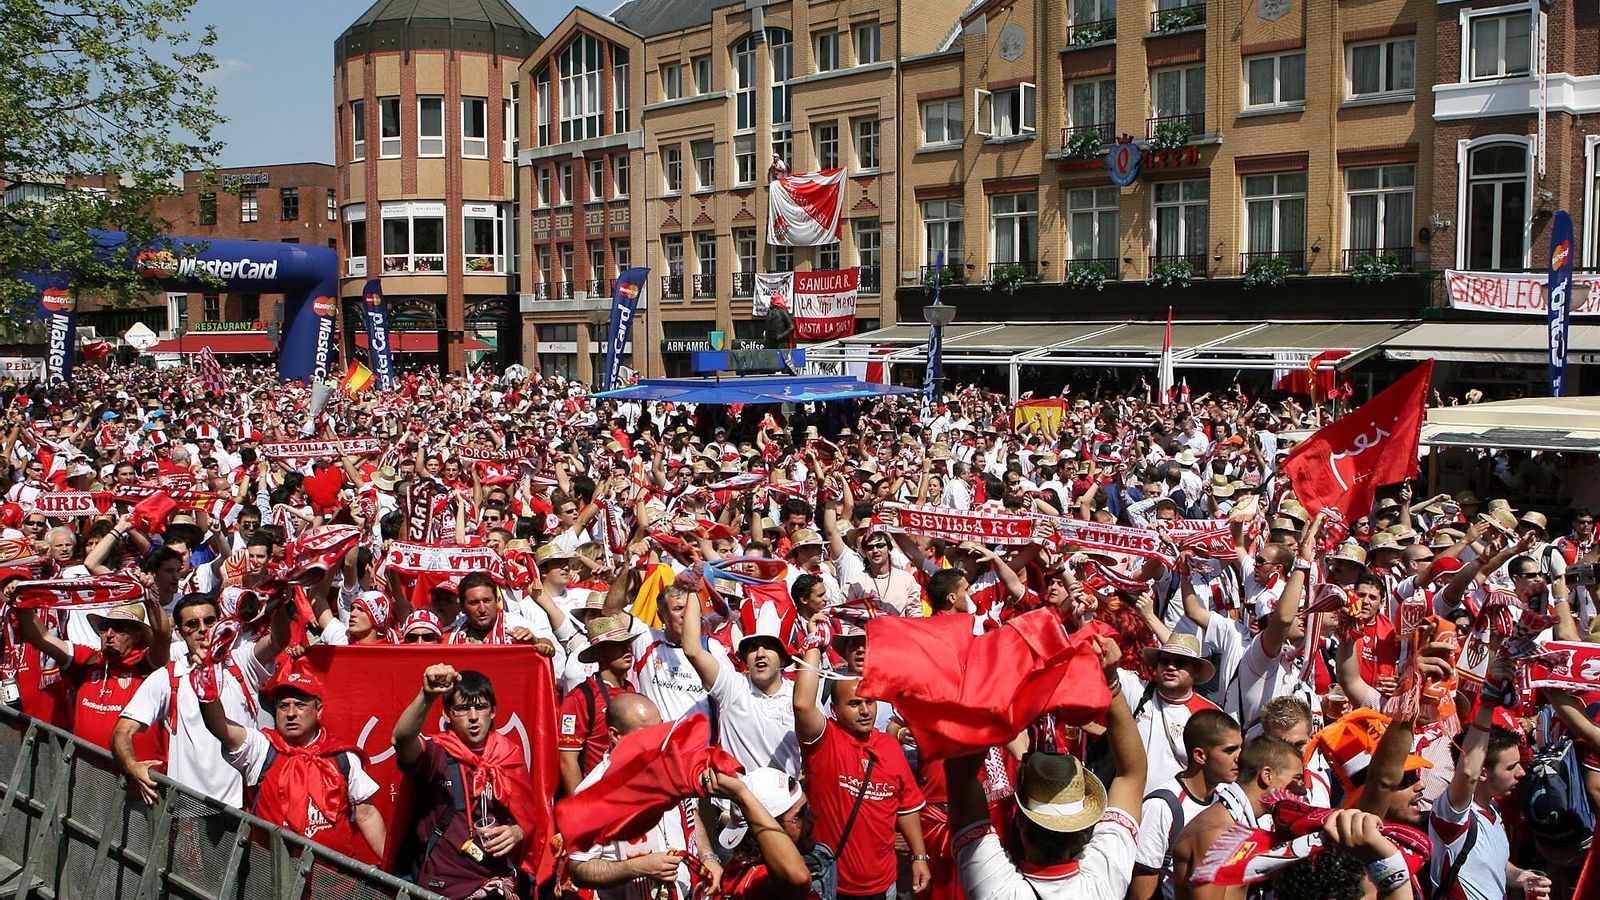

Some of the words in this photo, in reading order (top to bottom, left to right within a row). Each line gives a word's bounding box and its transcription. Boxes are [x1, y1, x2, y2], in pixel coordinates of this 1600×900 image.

[178, 256, 278, 280] MasterCard
[1450, 273, 1548, 311] GIBRALEO
[195, 321, 252, 331] RESTAURANT
[49, 313, 69, 388] MasterC
[314, 317, 332, 385] MasterCa
[368, 312, 390, 391] asterCard
[609, 303, 632, 391] sterCard
[740, 341, 765, 350] Selfse
[281, 443, 329, 453] SEVILLA
[35, 495, 91, 511] BIRIS
[910, 512, 985, 533] SEVILLA
[992, 520, 1022, 536] F.C.
[1165, 518, 1218, 531] SEVILLA
[1075, 528, 1156, 552] SEVILLA
[448, 554, 504, 577] VILLA
